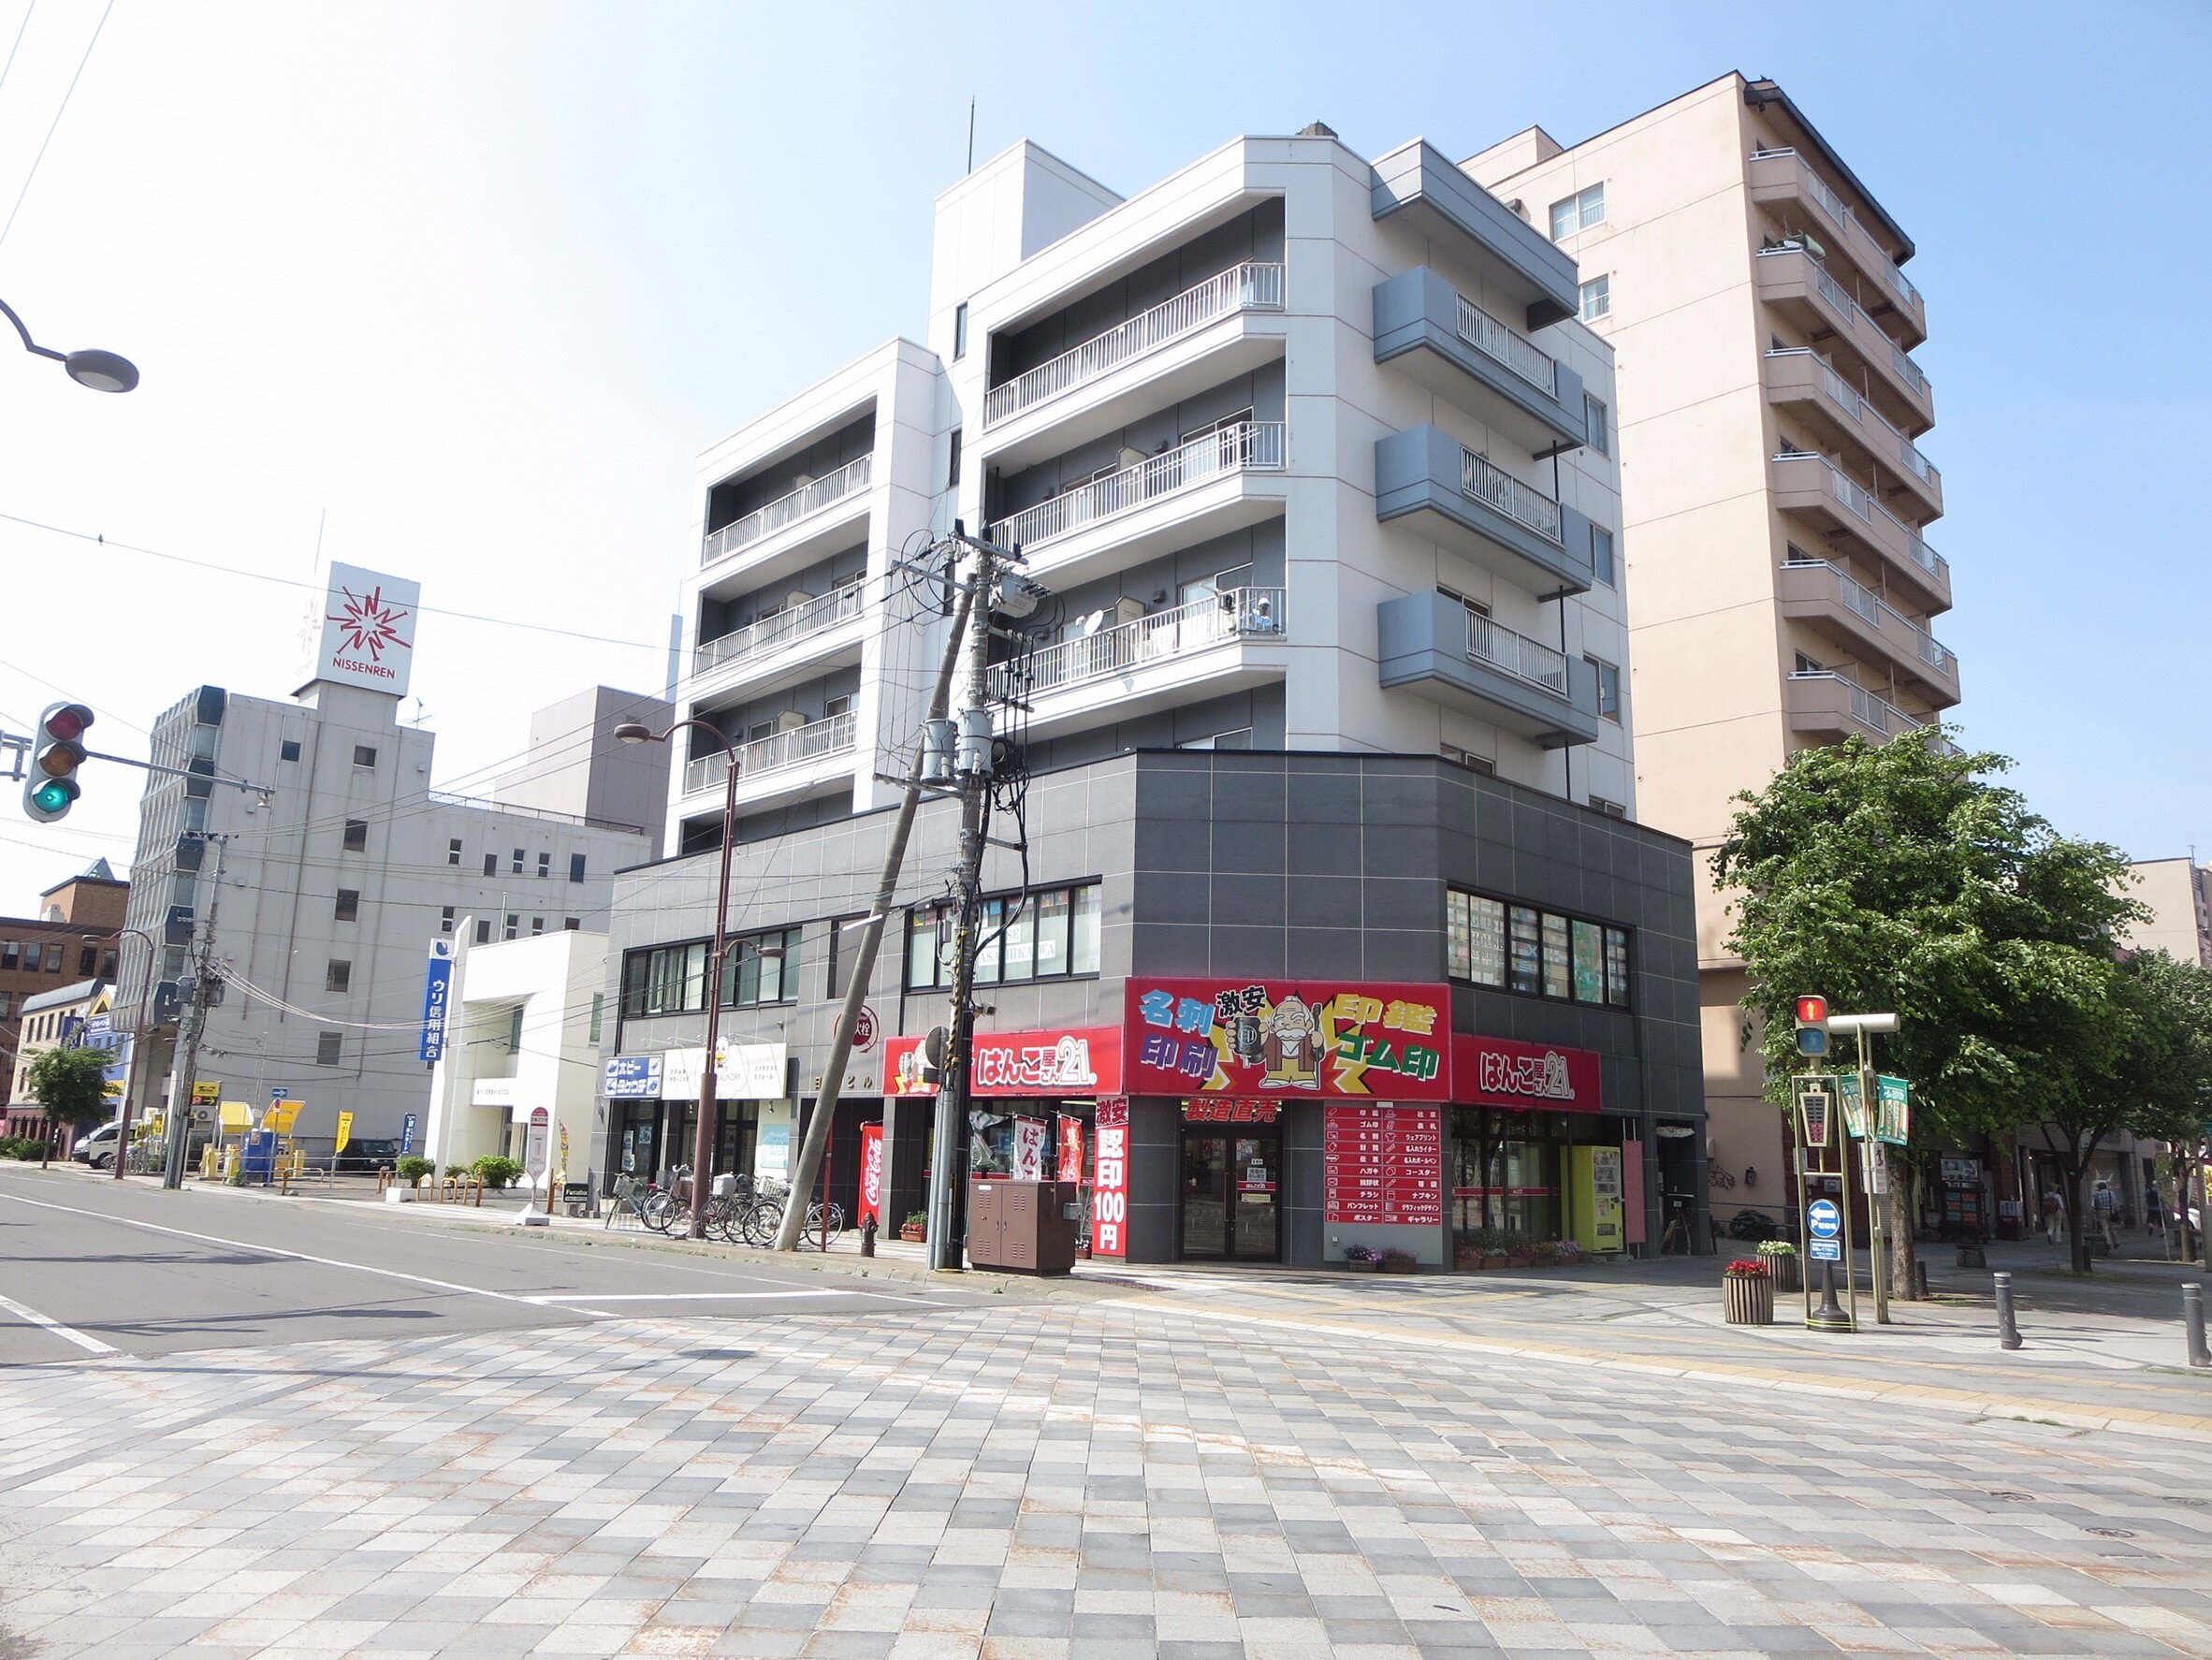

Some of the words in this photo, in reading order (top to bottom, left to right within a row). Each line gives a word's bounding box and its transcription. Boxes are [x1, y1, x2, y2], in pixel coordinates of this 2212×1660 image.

[332, 658, 395, 679] NISSENREN
[426, 979, 445, 1058] ウリ信用組合
[1139, 989, 1215, 1038] 名刺
[1215, 985, 1266, 1017] 激安
[1333, 994, 1437, 1036] 印鑑
[1141, 1033, 1218, 1081] 印刷
[1336, 1033, 1439, 1082] ゴム印
[1096, 1099, 1128, 1123] 激安
[1184, 1098, 1277, 1122] 製造直売
[866, 1134, 882, 1206] Coca-Cola
